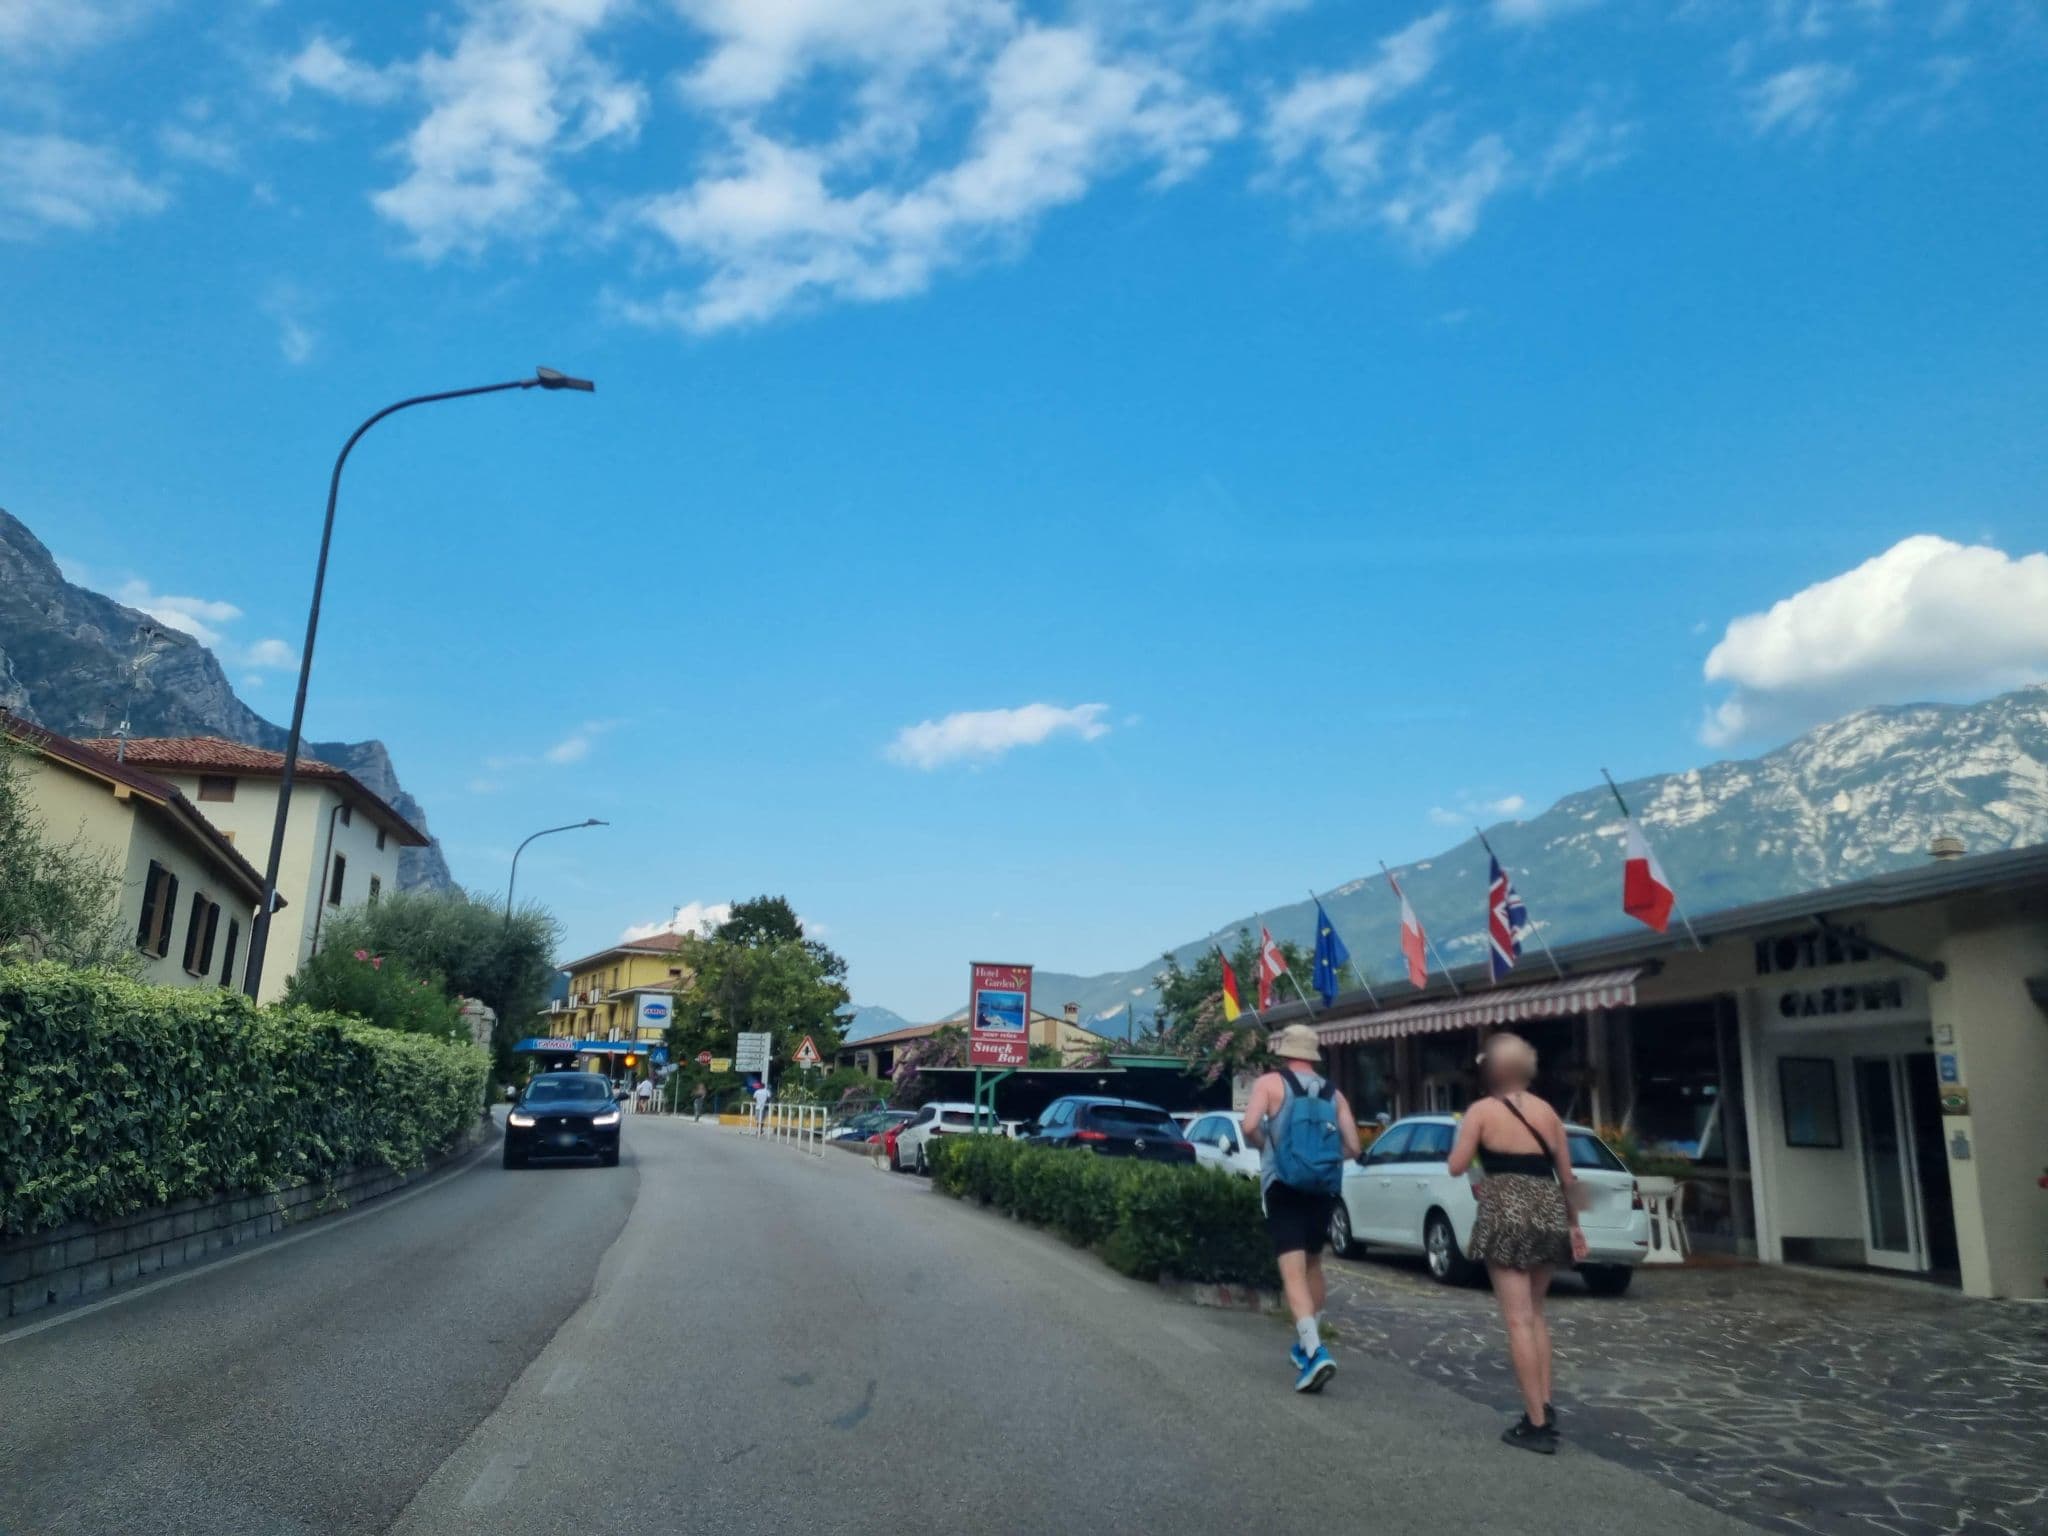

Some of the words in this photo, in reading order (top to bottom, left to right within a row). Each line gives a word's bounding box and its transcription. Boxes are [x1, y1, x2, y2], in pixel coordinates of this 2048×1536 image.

[975, 967, 999, 978] Hotel
[985, 978, 1016, 988] Garden
[1780, 979, 1904, 1018] GARDEN
[973, 1042, 1013, 1053] Snack
[998, 1053, 1024, 1063] Bar
